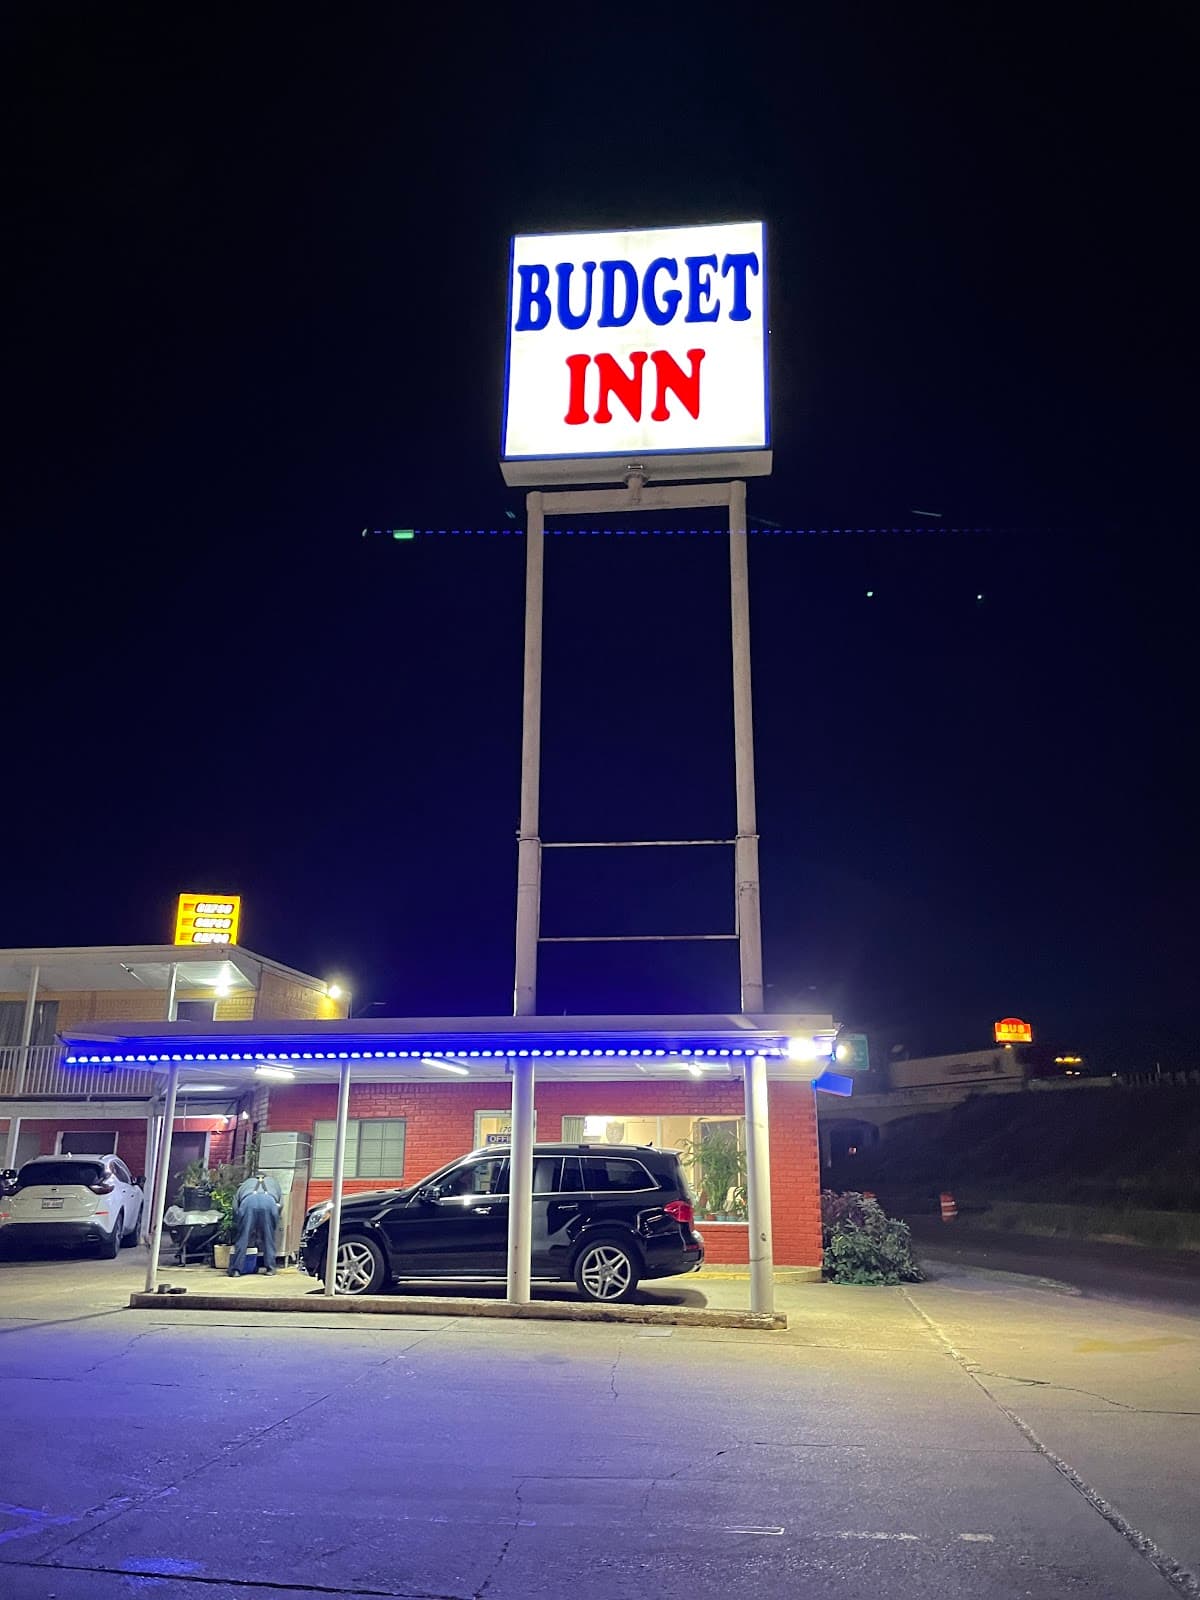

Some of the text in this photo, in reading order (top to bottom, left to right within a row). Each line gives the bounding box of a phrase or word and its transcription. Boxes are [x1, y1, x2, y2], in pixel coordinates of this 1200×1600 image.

[515, 252, 759, 332] BUDGET
[564, 348, 706, 425] INN
[489, 1135, 509, 1143] OFFI
